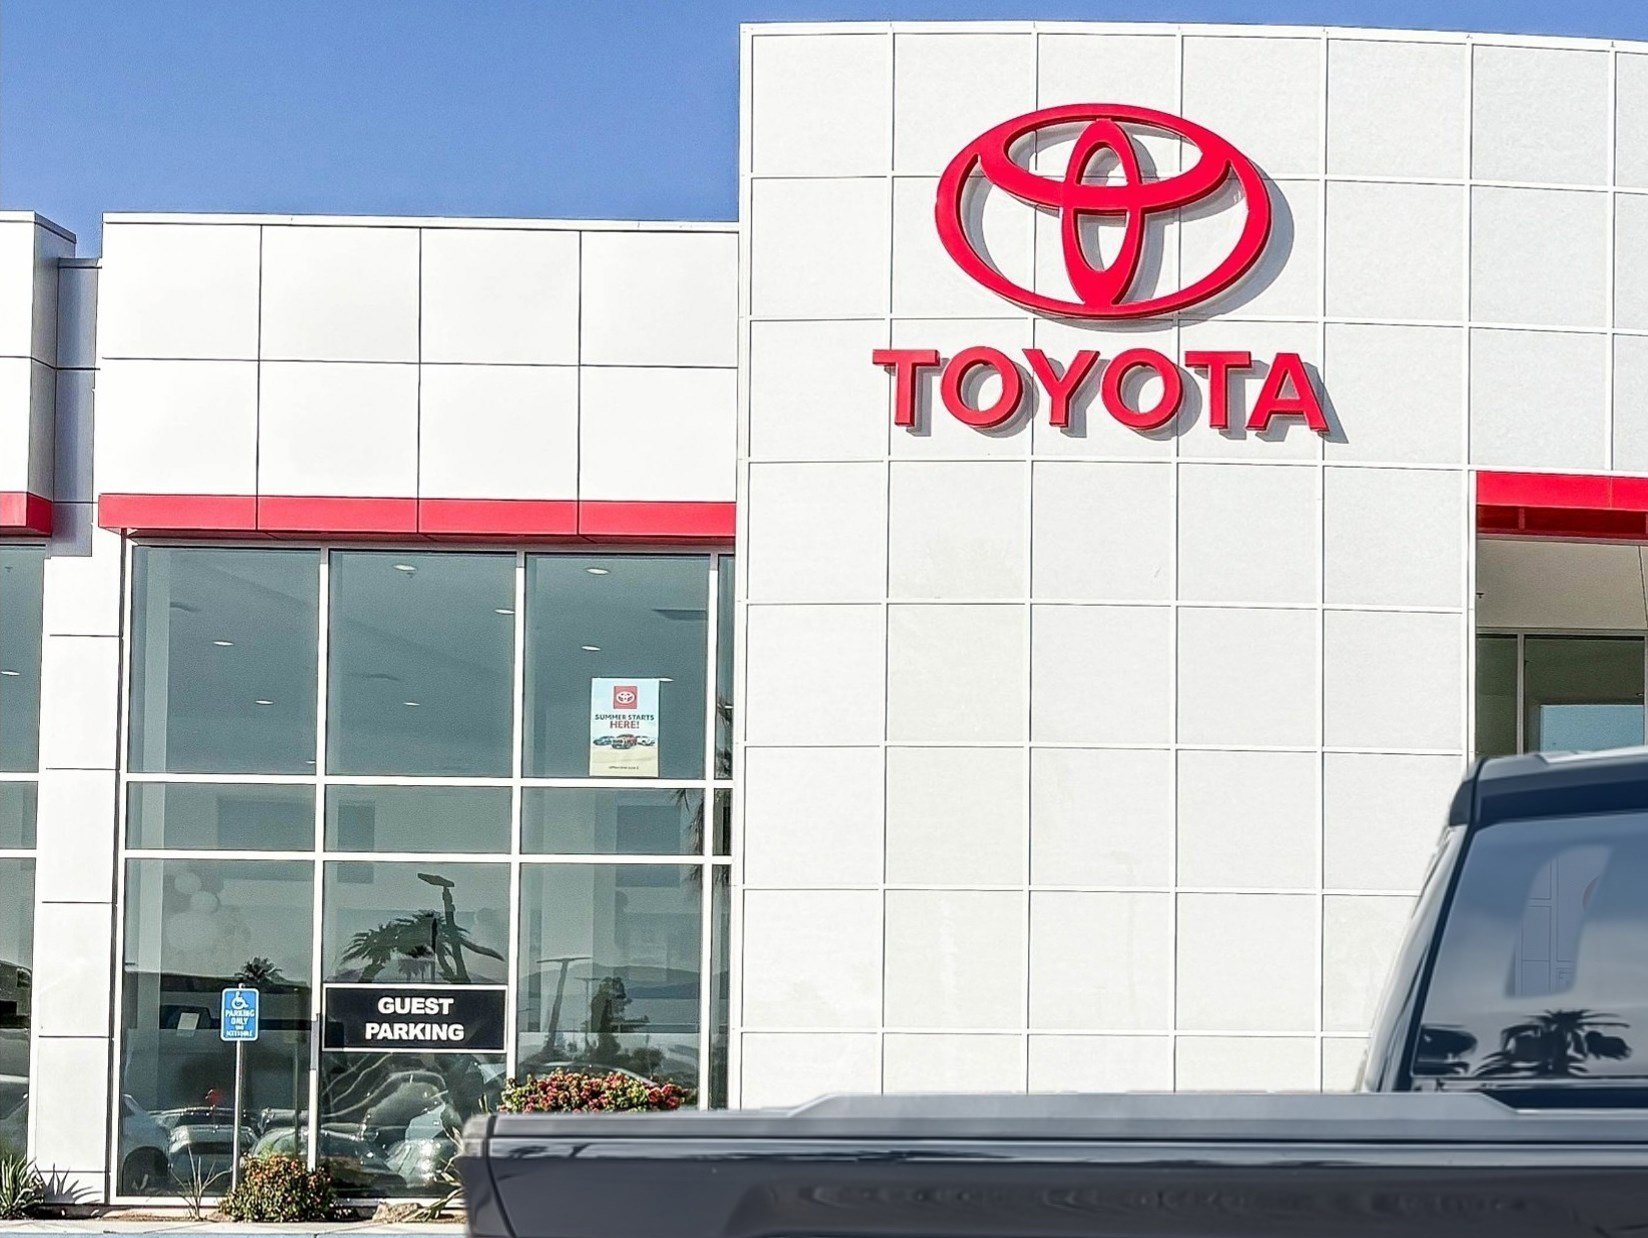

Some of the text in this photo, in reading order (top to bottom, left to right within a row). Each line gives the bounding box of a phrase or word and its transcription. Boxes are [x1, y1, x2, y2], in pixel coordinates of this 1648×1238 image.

[872, 345, 1331, 433] TOYOTA
[609, 721, 640, 729] HERE!
[225, 1009, 255, 1017] PARKING
[377, 997, 454, 1015] GUEST
[365, 1022, 465, 1041] PARKING
